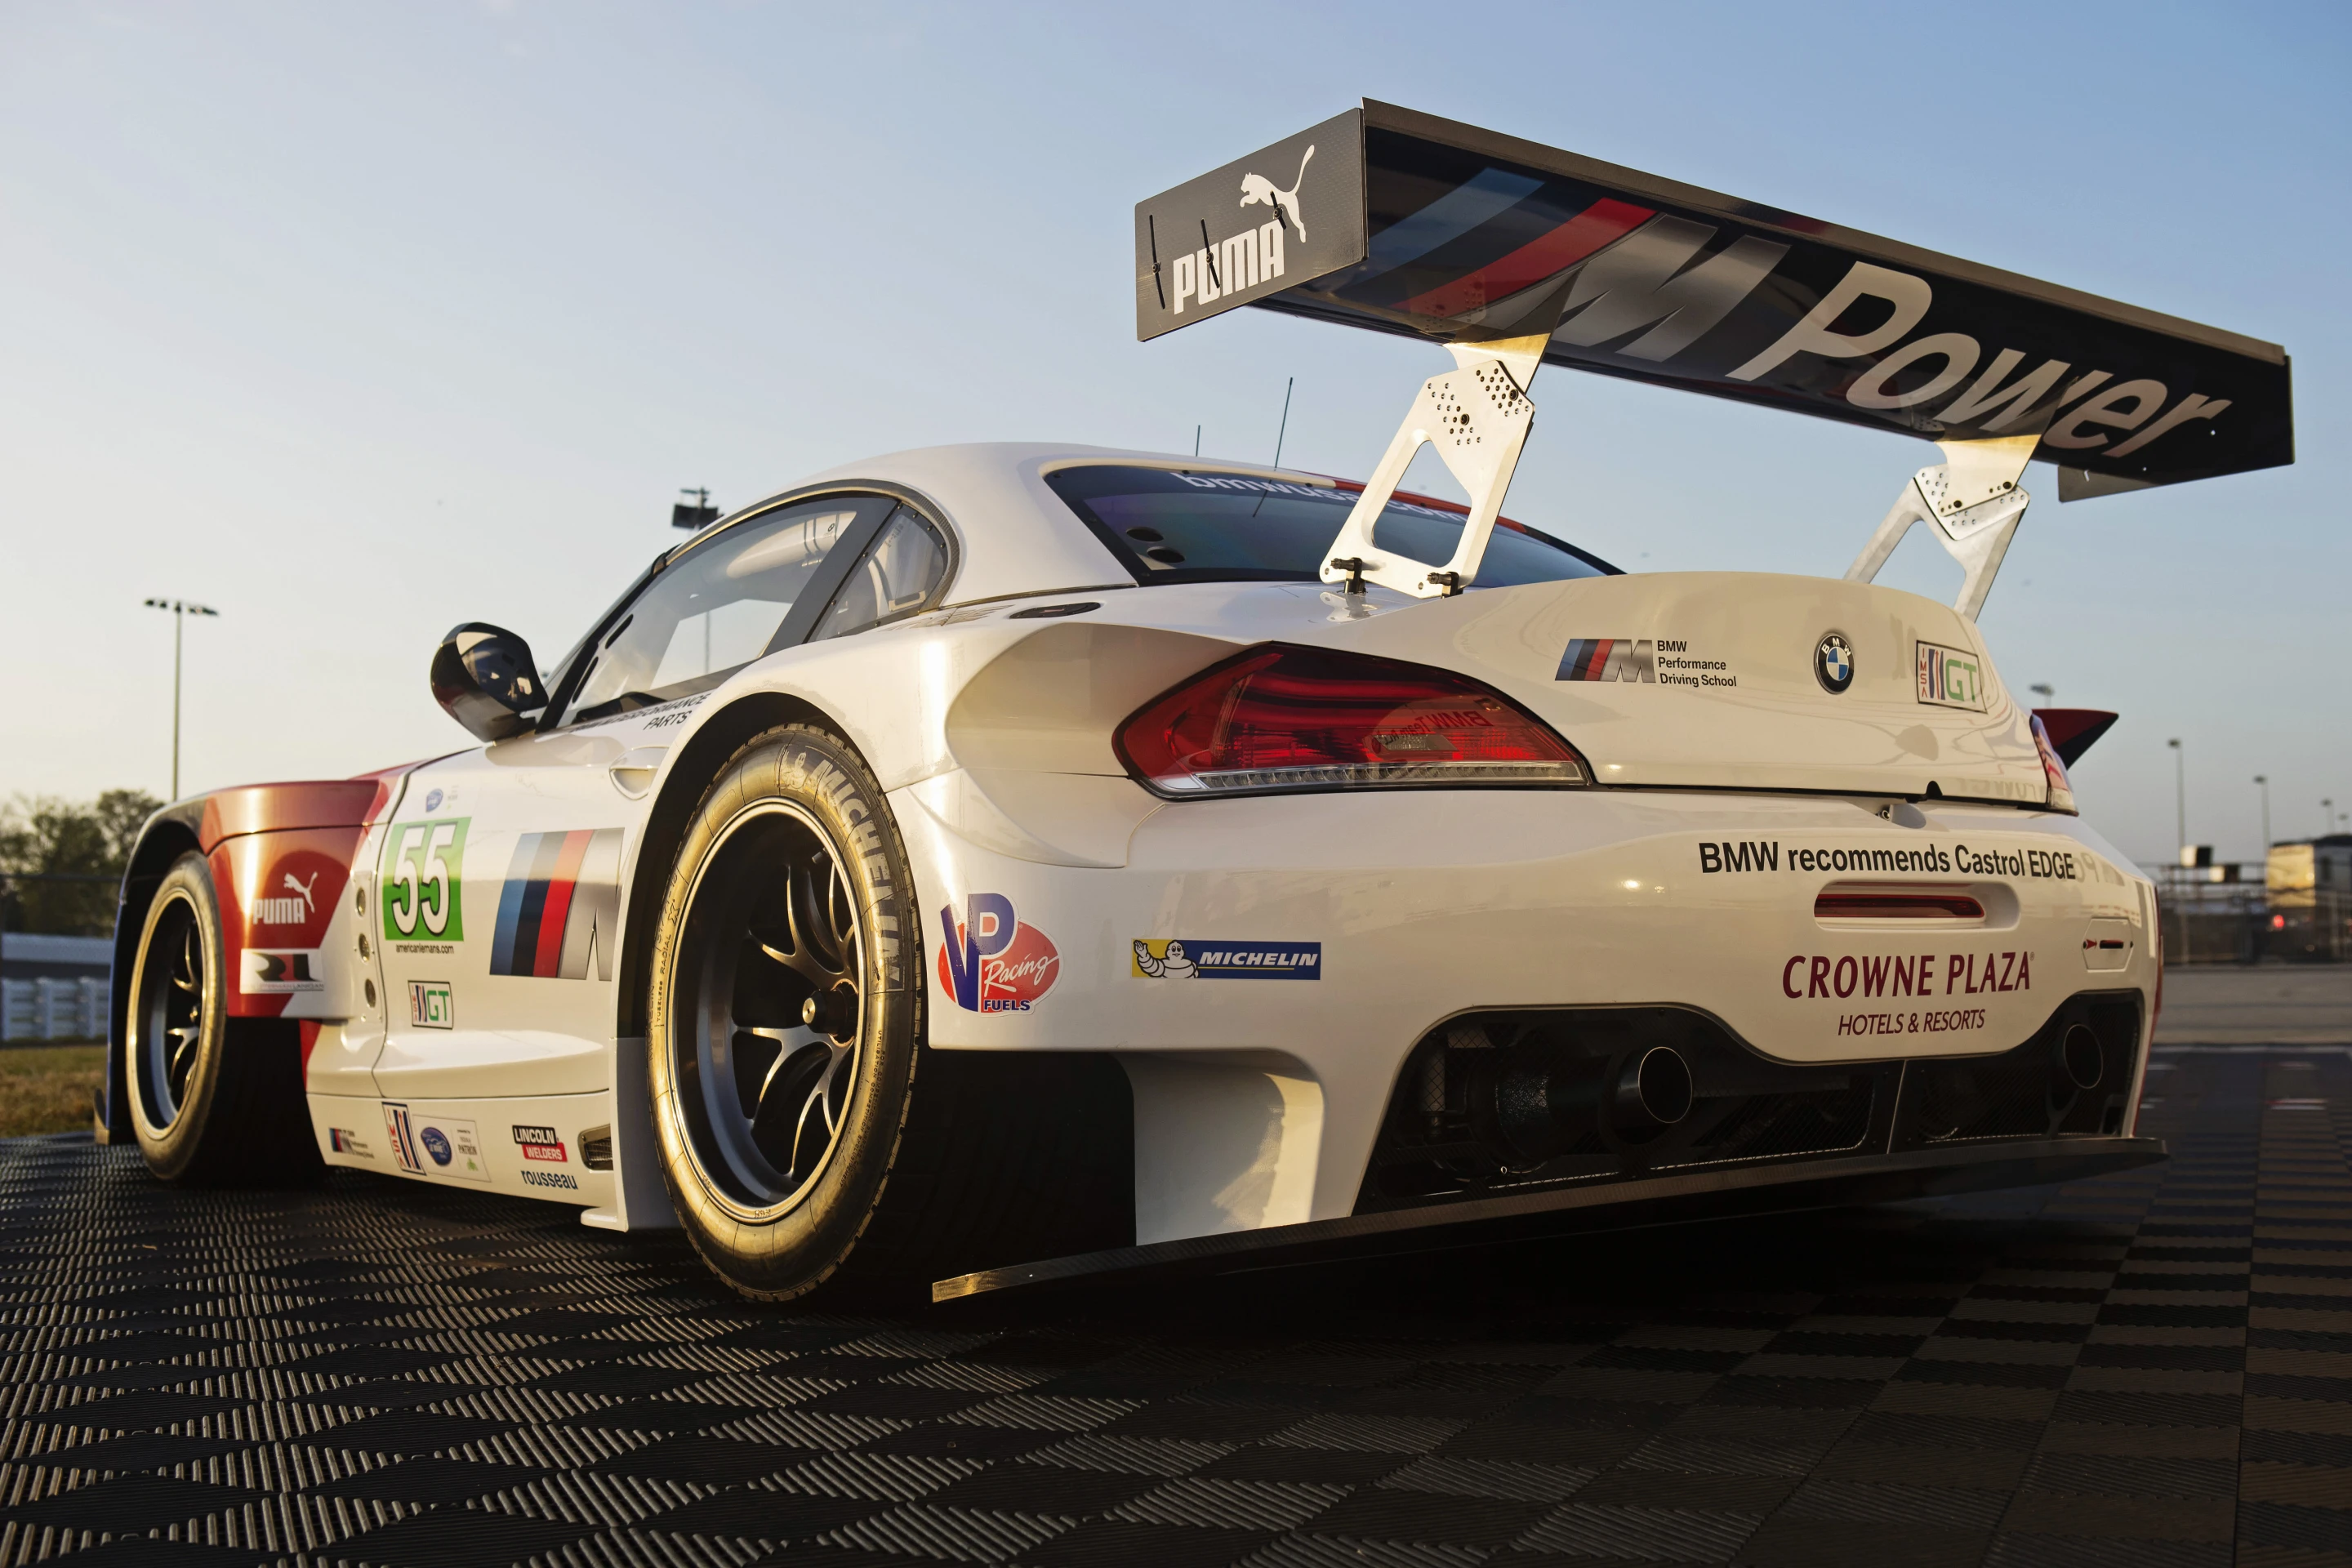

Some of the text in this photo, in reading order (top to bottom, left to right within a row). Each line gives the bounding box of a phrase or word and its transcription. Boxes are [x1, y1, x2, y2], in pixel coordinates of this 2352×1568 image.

[1173, 220, 1285, 315] PUMA
[1725, 260, 2233, 458] Power
[1657, 640, 1687, 653] BMW
[1822, 637, 1852, 657] BMW
[1658, 657, 1726, 670] Performance
[1659, 673, 1737, 688] Driving School
[1945, 658, 1977, 702] GT
[643, 710, 692, 730] PARTS
[805, 759, 900, 982] MICHELIN
[1699, 842, 1779, 874] BMW
[1788, 844, 1950, 873] recommends
[1955, 844, 2025, 877] Castrol
[2030, 850, 2076, 880] EDGE
[392, 822, 458, 938] 55
[252, 898, 305, 924] PUMA
[660, 933, 670, 974] RADIAL
[941, 893, 1014, 1012] VP
[1199, 951, 1318, 966] MICHELIN
[984, 953, 1058, 997] Racing
[1783, 951, 2030, 999] CROWNE PLAZA
[426, 990, 449, 1021] GT
[984, 1000, 1031, 1011] FUELS
[1838, 1009, 1985, 1036] HOTELS & RESORTS
[514, 1128, 555, 1144] LINCOLN
[526, 1147, 564, 1160] WELDERS
[521, 1169, 578, 1190] rousseau
